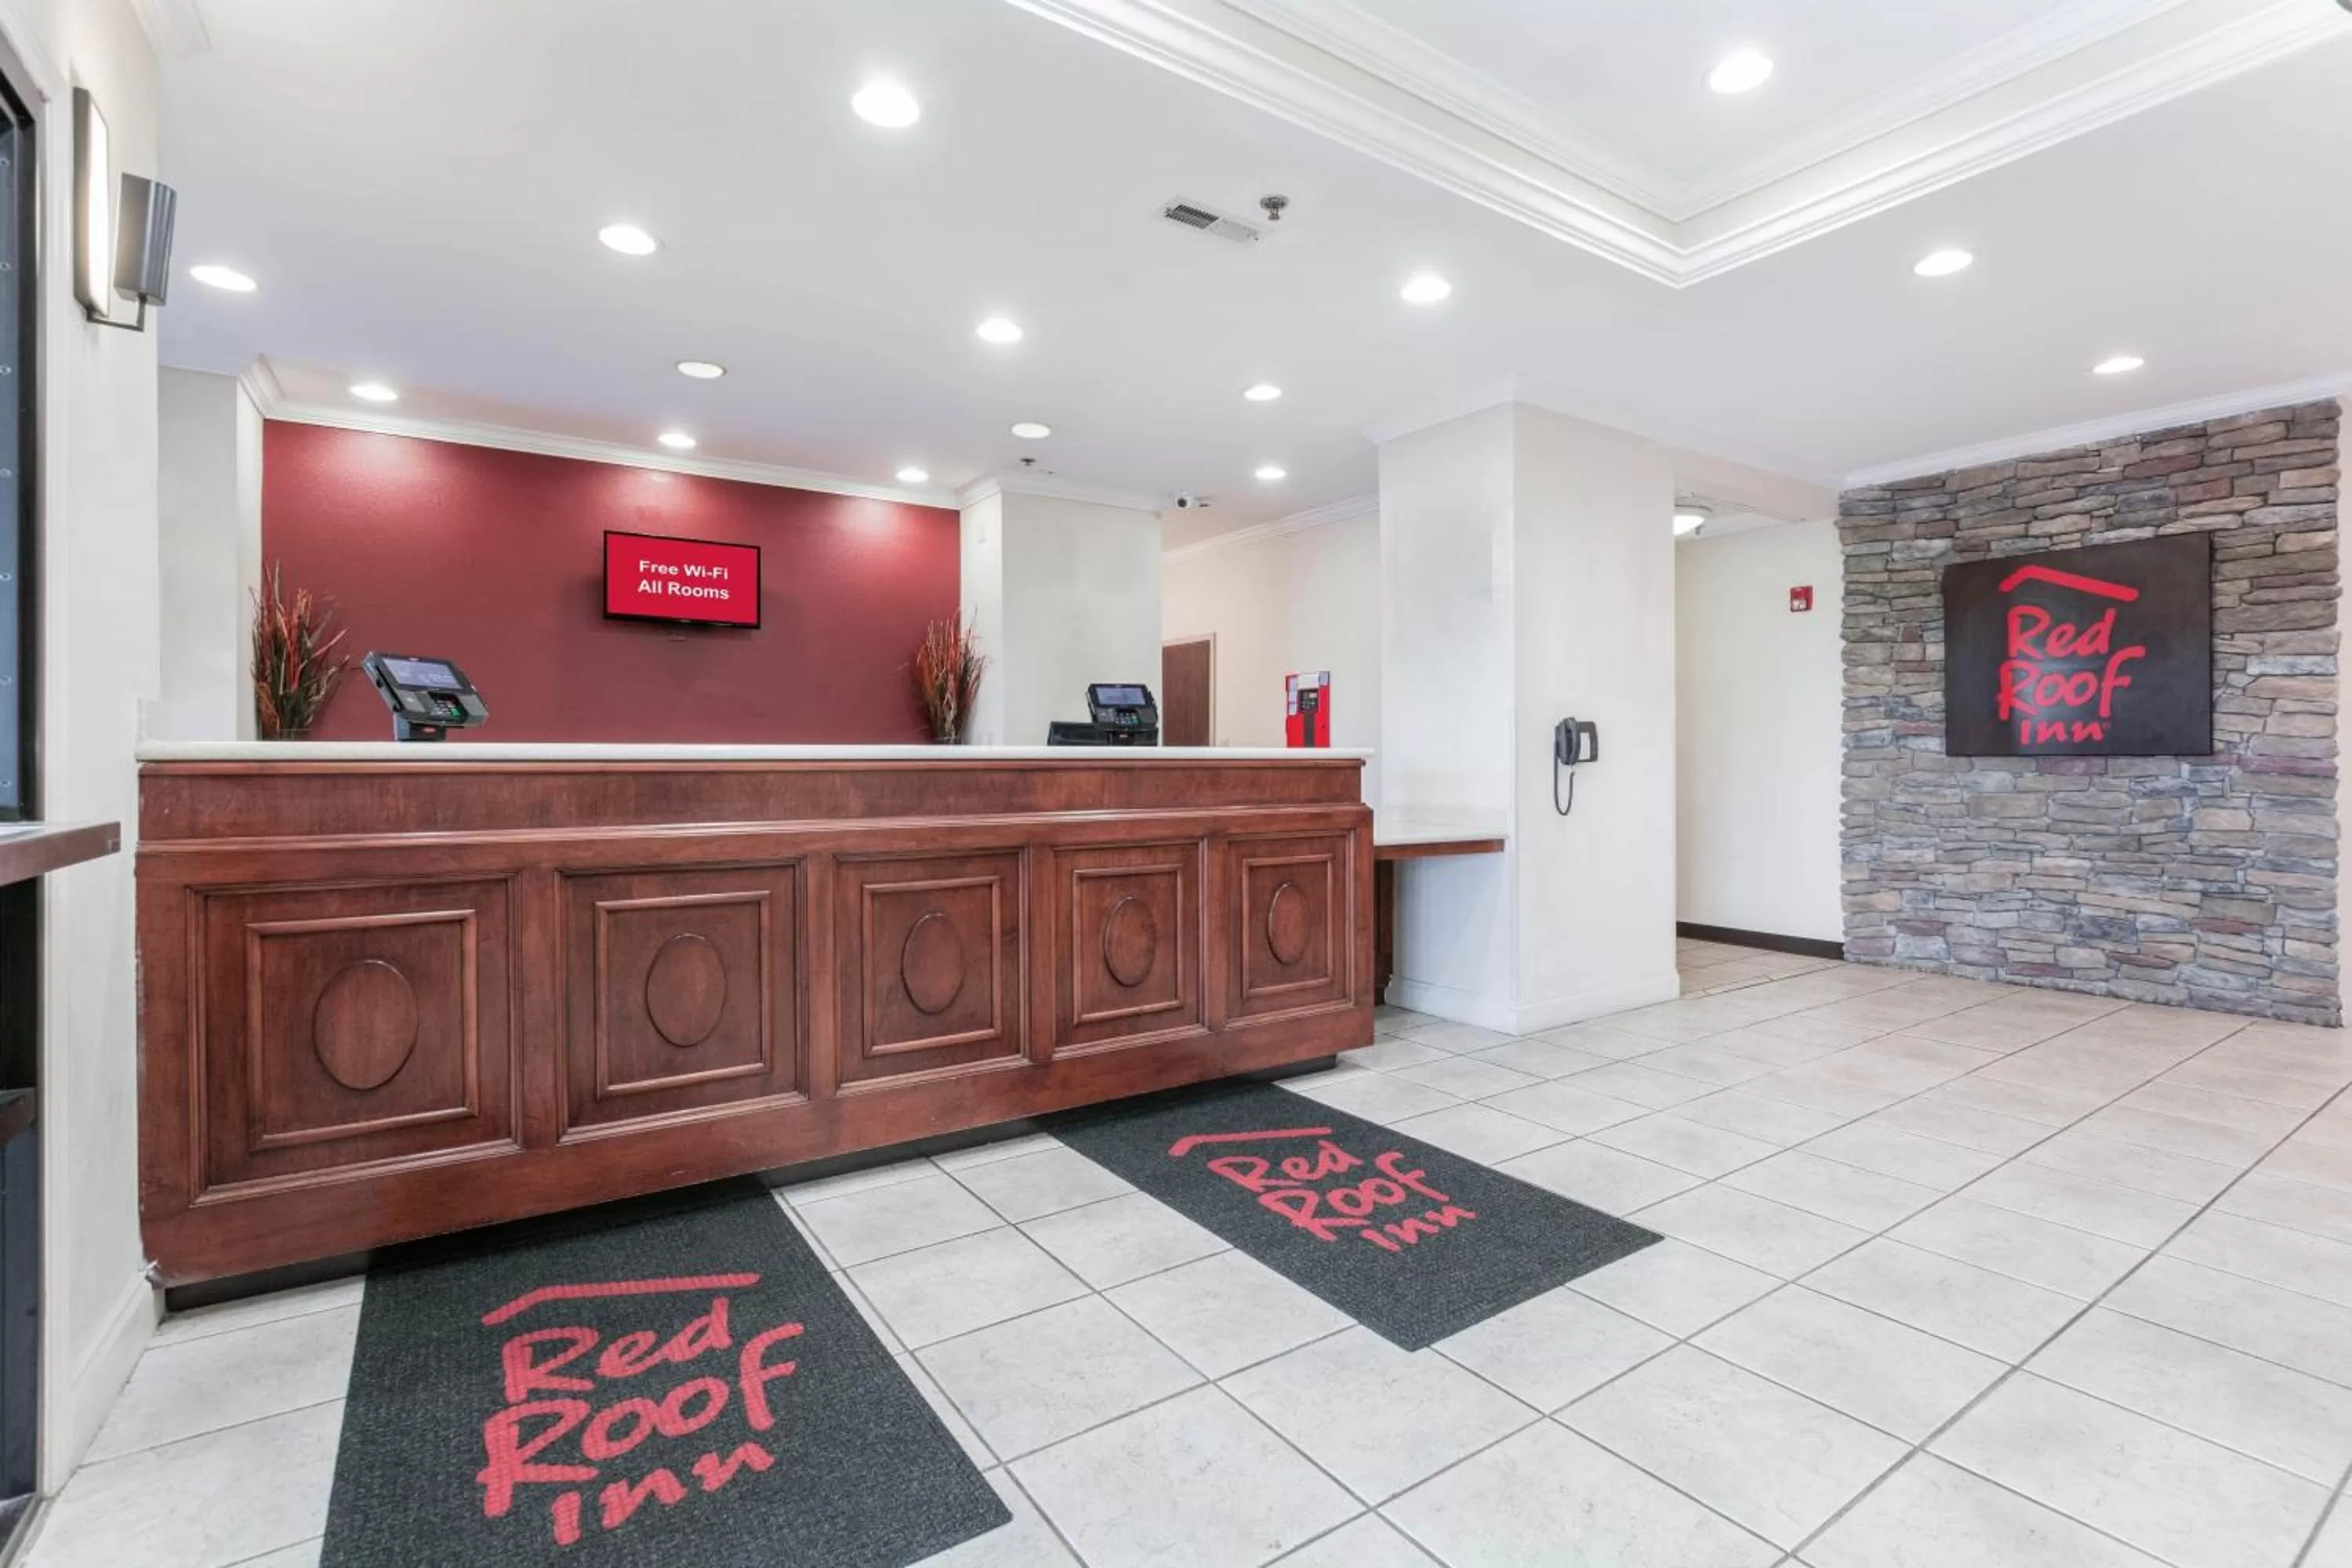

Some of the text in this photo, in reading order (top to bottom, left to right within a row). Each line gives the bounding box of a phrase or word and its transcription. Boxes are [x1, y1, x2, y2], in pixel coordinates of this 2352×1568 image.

[637, 579, 729, 600] All Rooms
[639, 560, 728, 580] Free Wi-Fi
[2007, 605, 2116, 660] Red
[1996, 645, 2146, 721] Roof
[1207, 1140, 1364, 1192] Red
[1258, 1152, 1450, 1242] Roof
[502, 1298, 735, 1403] Red
[476, 1322, 804, 1517] Roof
